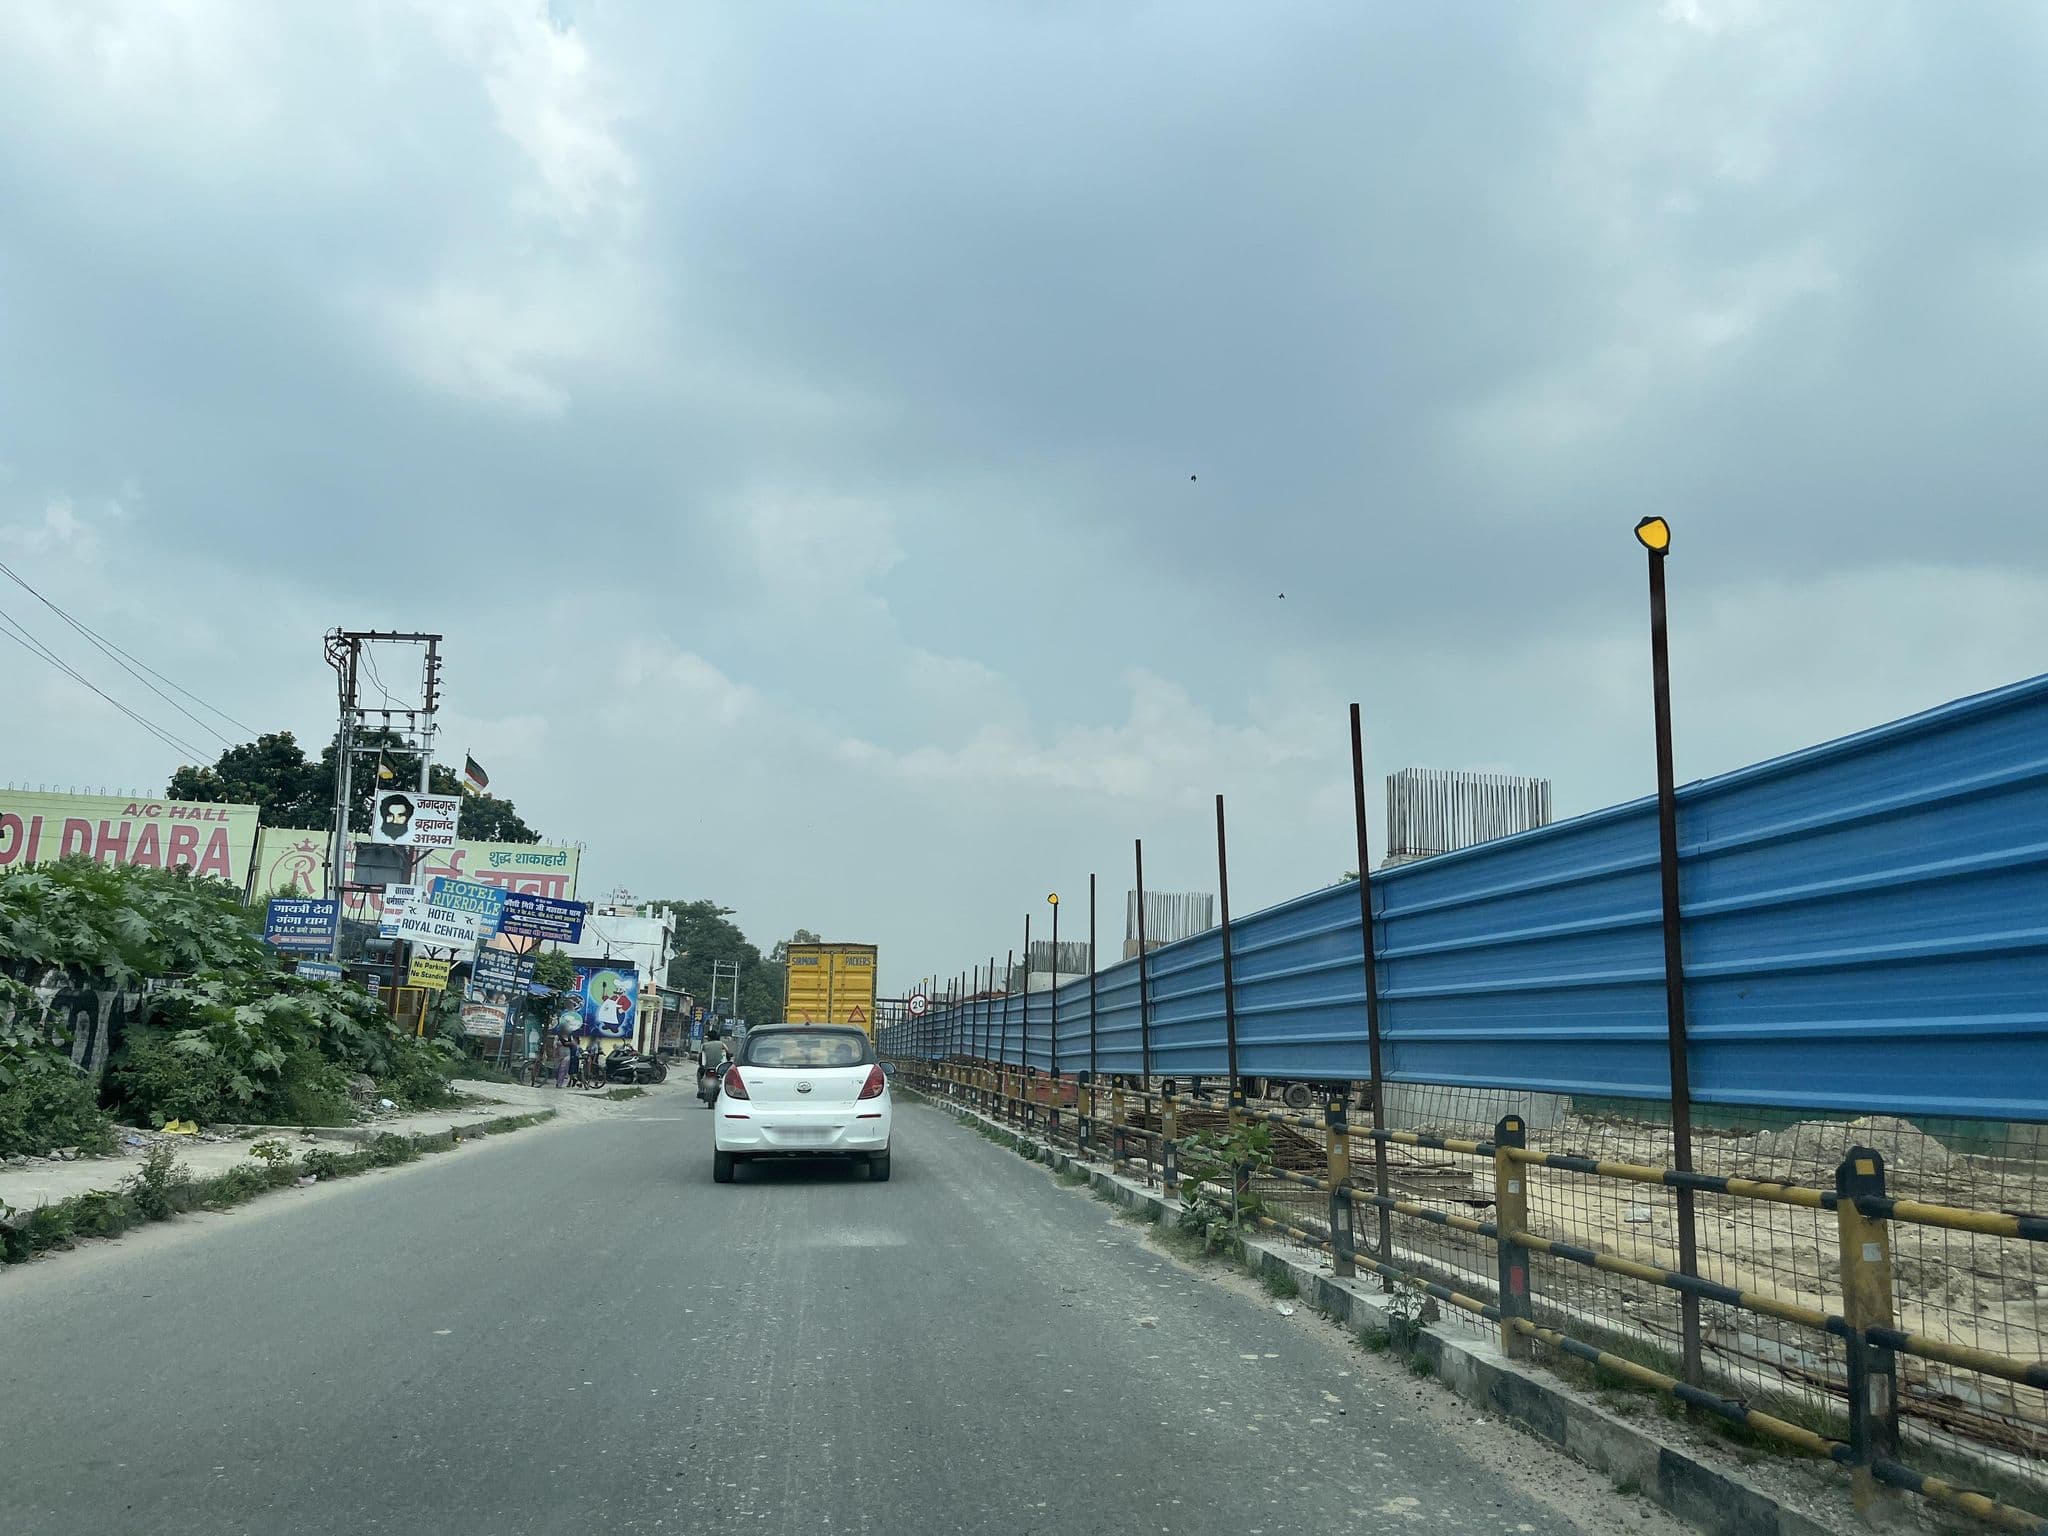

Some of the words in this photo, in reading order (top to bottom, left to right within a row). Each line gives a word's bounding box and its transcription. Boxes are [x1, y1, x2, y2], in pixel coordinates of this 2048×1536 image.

[122, 803, 162, 818] A/C
[168, 805, 230, 822] HALL
[415, 817, 454, 832] ब्रह्मानंद
[413, 833, 454, 845] आश्रम
[59, 818, 231, 878] DHABA
[488, 851, 511, 867] शुद्ध
[515, 851, 567, 867] शाकाहारी
[442, 880, 497, 901] HOTEL
[274, 904, 310, 914] गायत्री
[313, 904, 333, 914] देवी
[432, 892, 502, 917] RIVERDALE
[276, 914, 303, 925] गंगा
[305, 917, 328, 925] धाम
[428, 907, 456, 922] HOTEL
[402, 918, 431, 933] ROYAL
[434, 924, 475, 941] CENTRAL
[424, 962, 448, 972] Parking
[421, 971, 448, 982] Standing
[912, 1000, 924, 1009] 20
